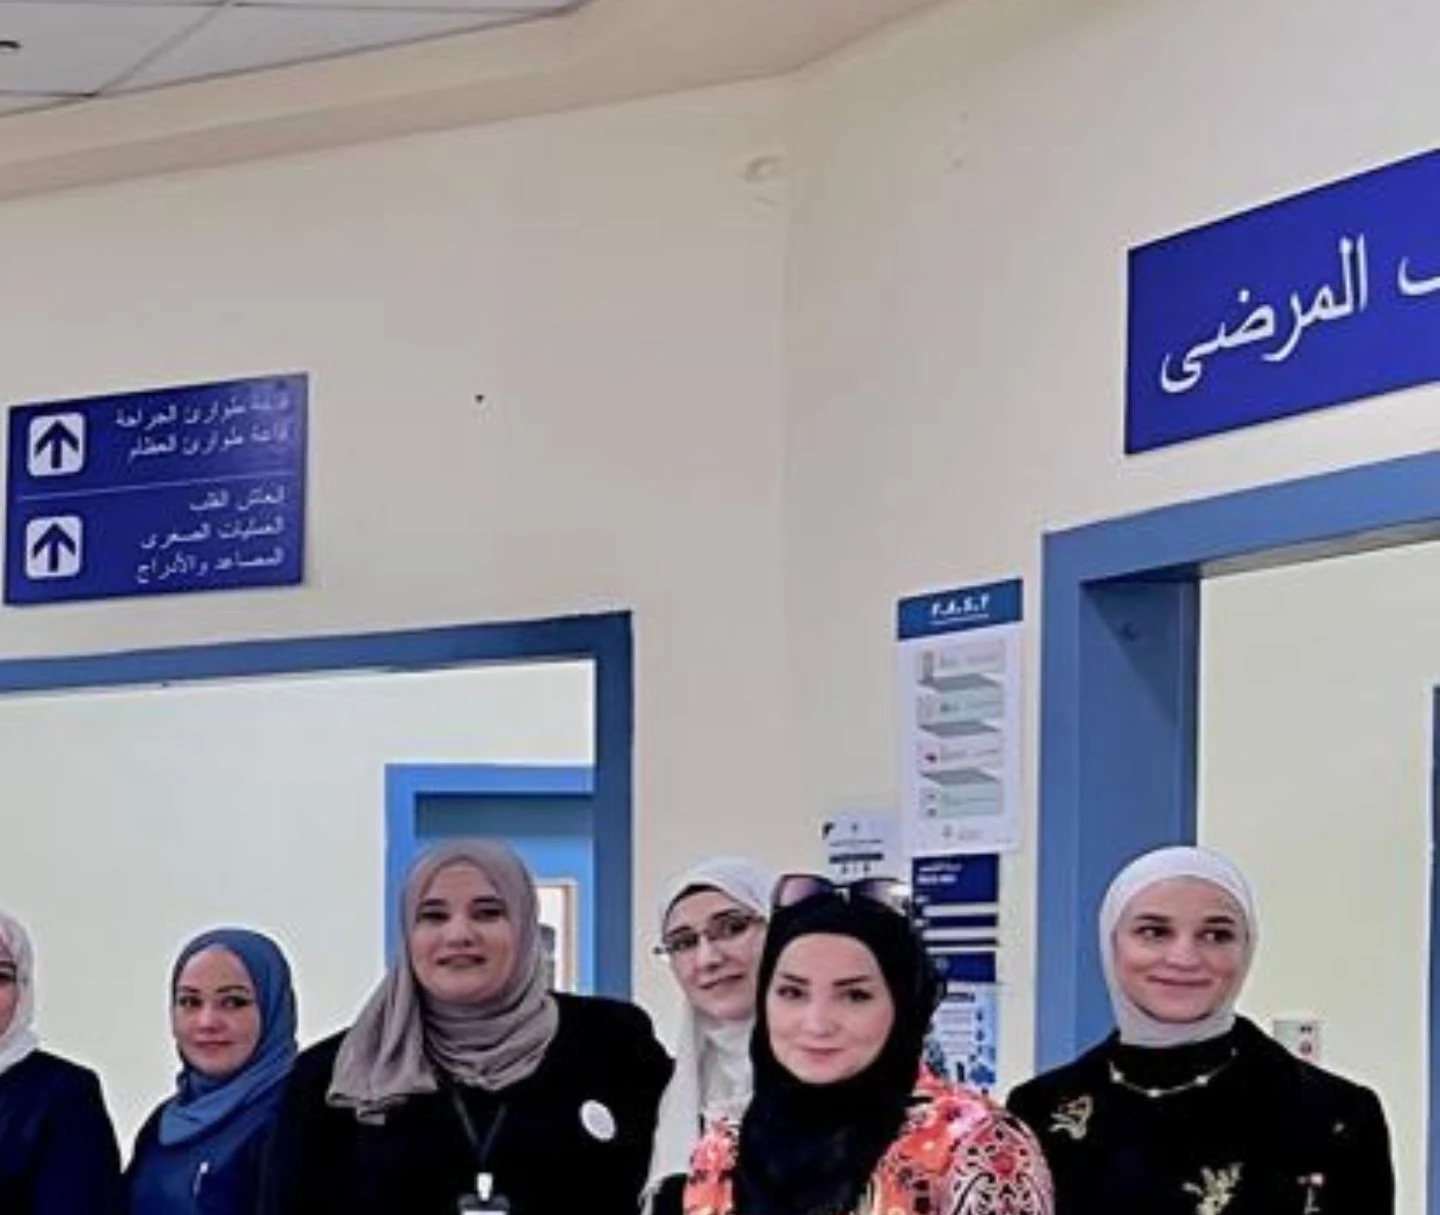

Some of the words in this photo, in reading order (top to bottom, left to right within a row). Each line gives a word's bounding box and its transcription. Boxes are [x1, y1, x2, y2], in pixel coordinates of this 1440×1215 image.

[1161, 232, 1368, 393] المرضى
[115, 404, 178, 431] الجراحة
[140, 522, 212, 550] الصغرى
[218, 516, 285, 542] العمليات
[214, 547, 285, 570] المصاعد
